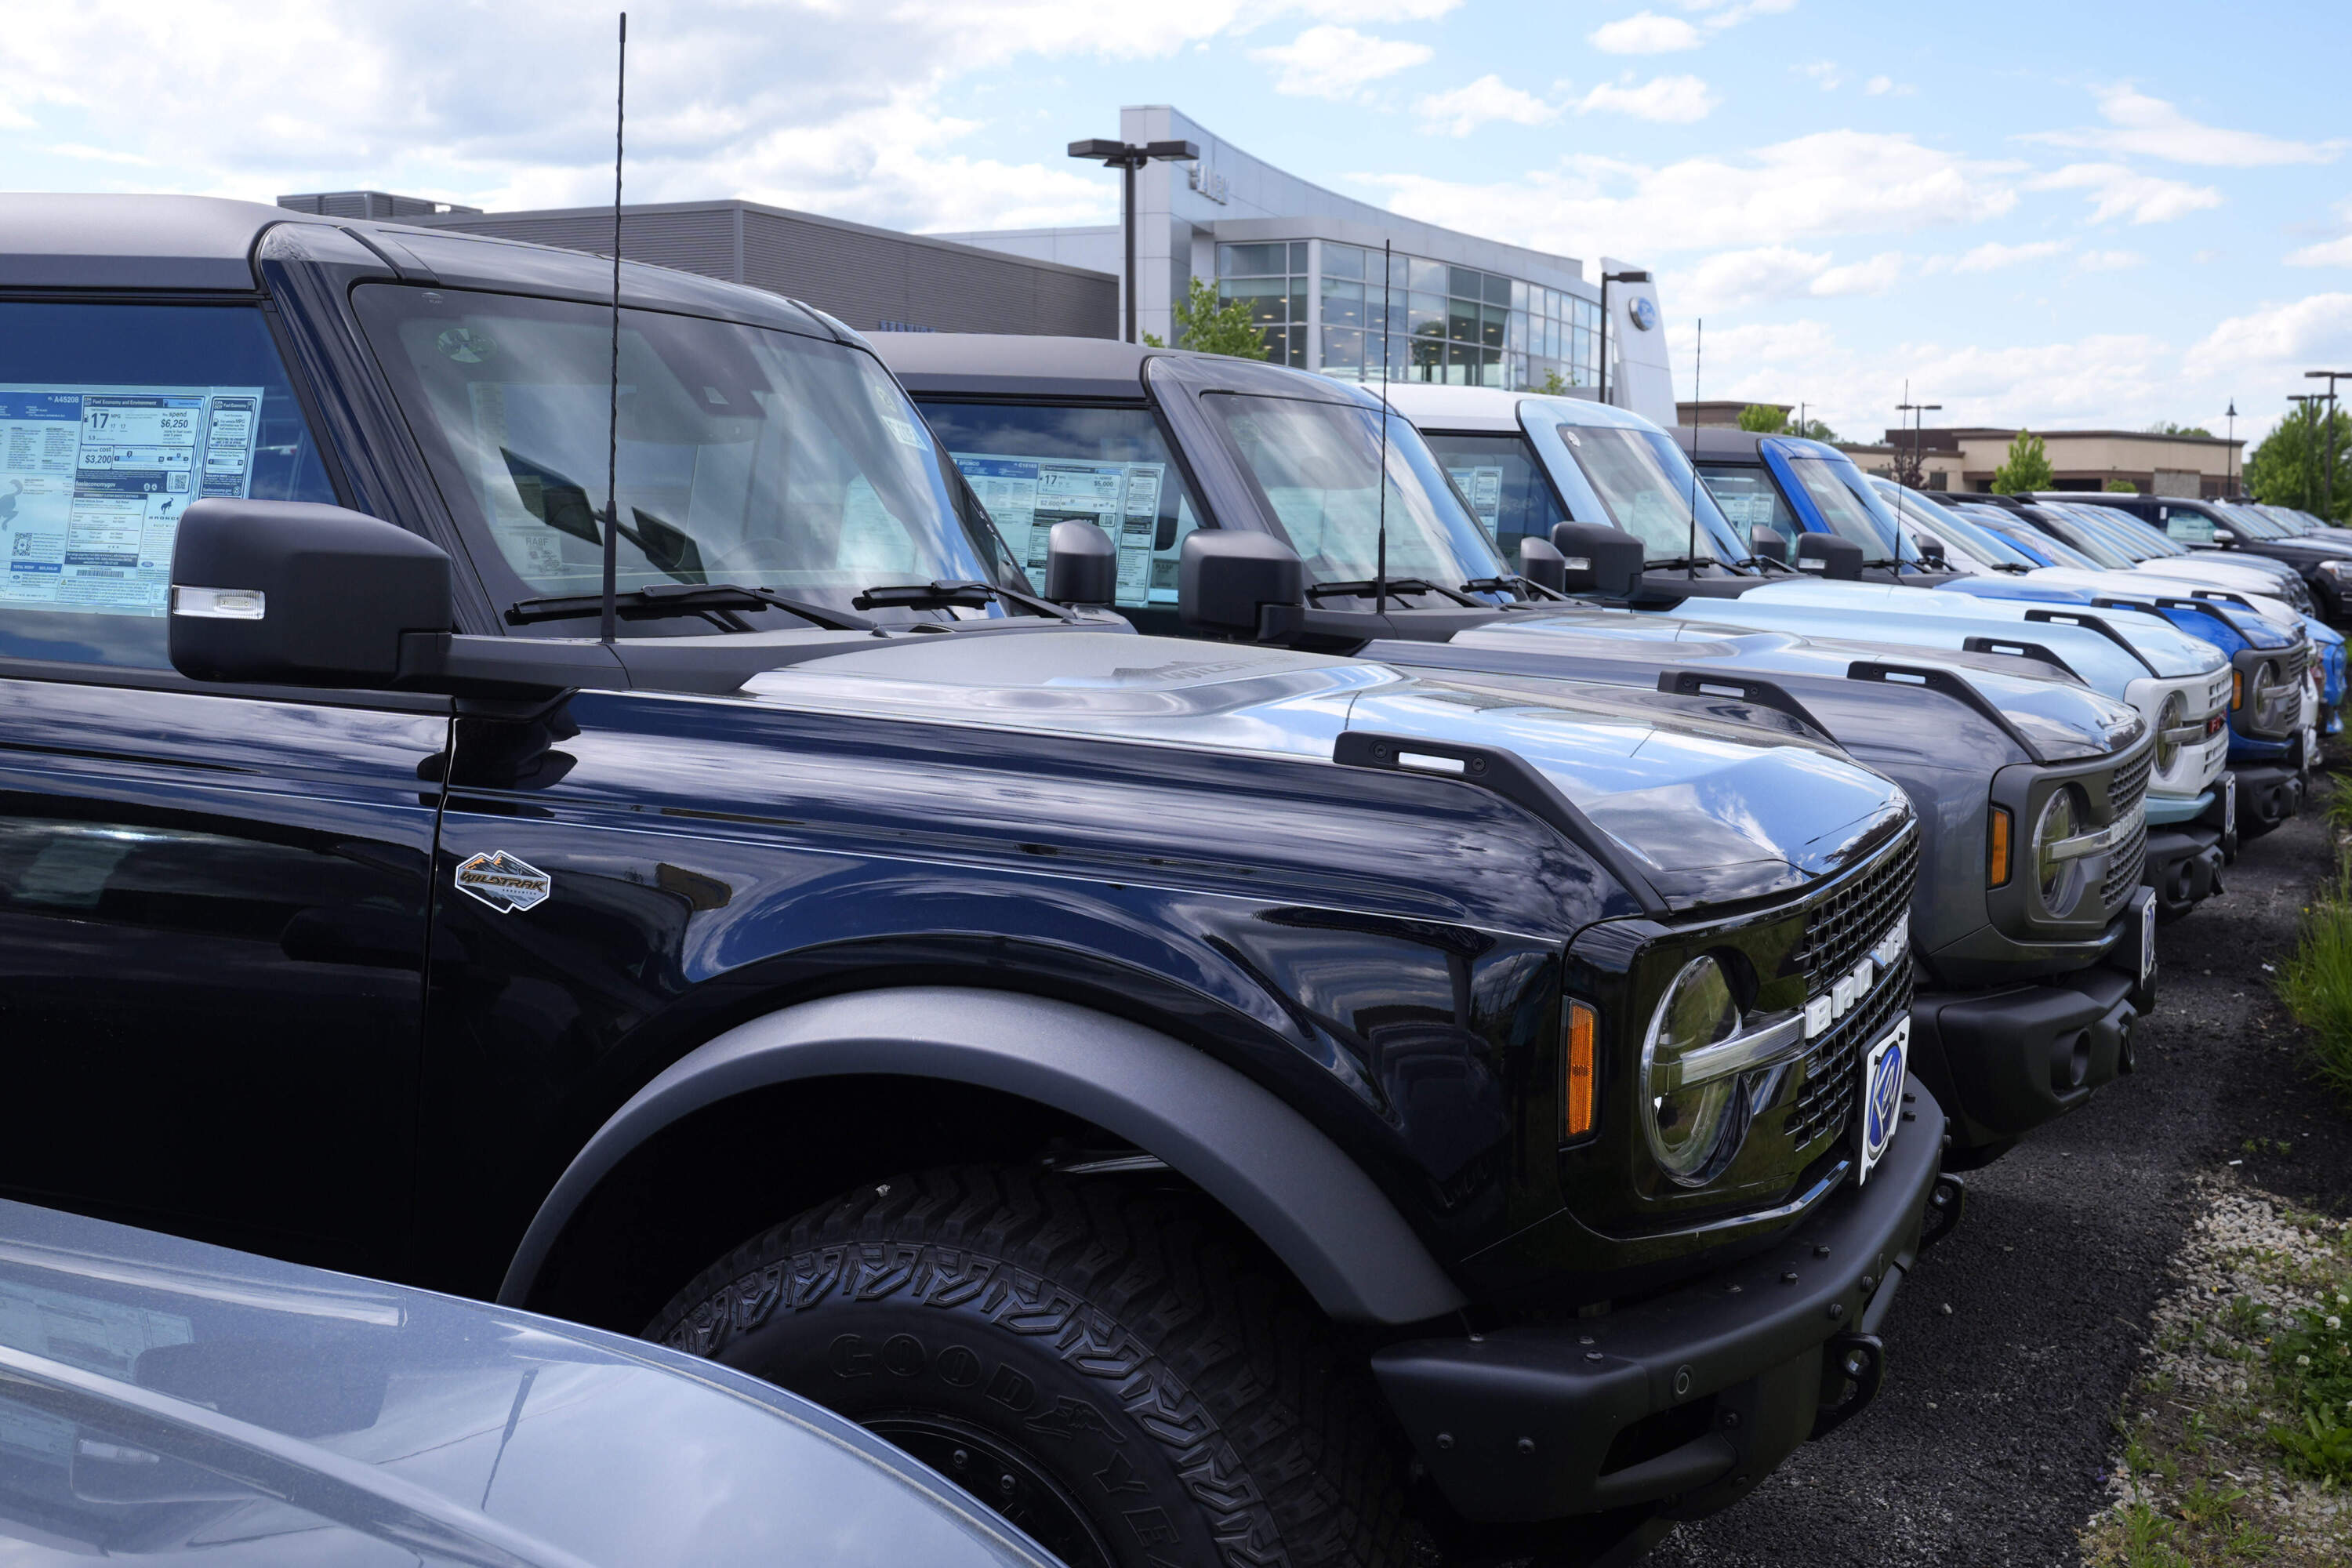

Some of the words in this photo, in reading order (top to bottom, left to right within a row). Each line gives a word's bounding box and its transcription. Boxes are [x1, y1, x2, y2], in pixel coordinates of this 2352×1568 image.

[91, 412, 109, 429] 17
[161, 419, 188, 429] $6,250
[85, 455, 111, 464] $3,200
[1045, 474, 1058, 485] 17
[460, 871, 547, 893] WILDTRAK
